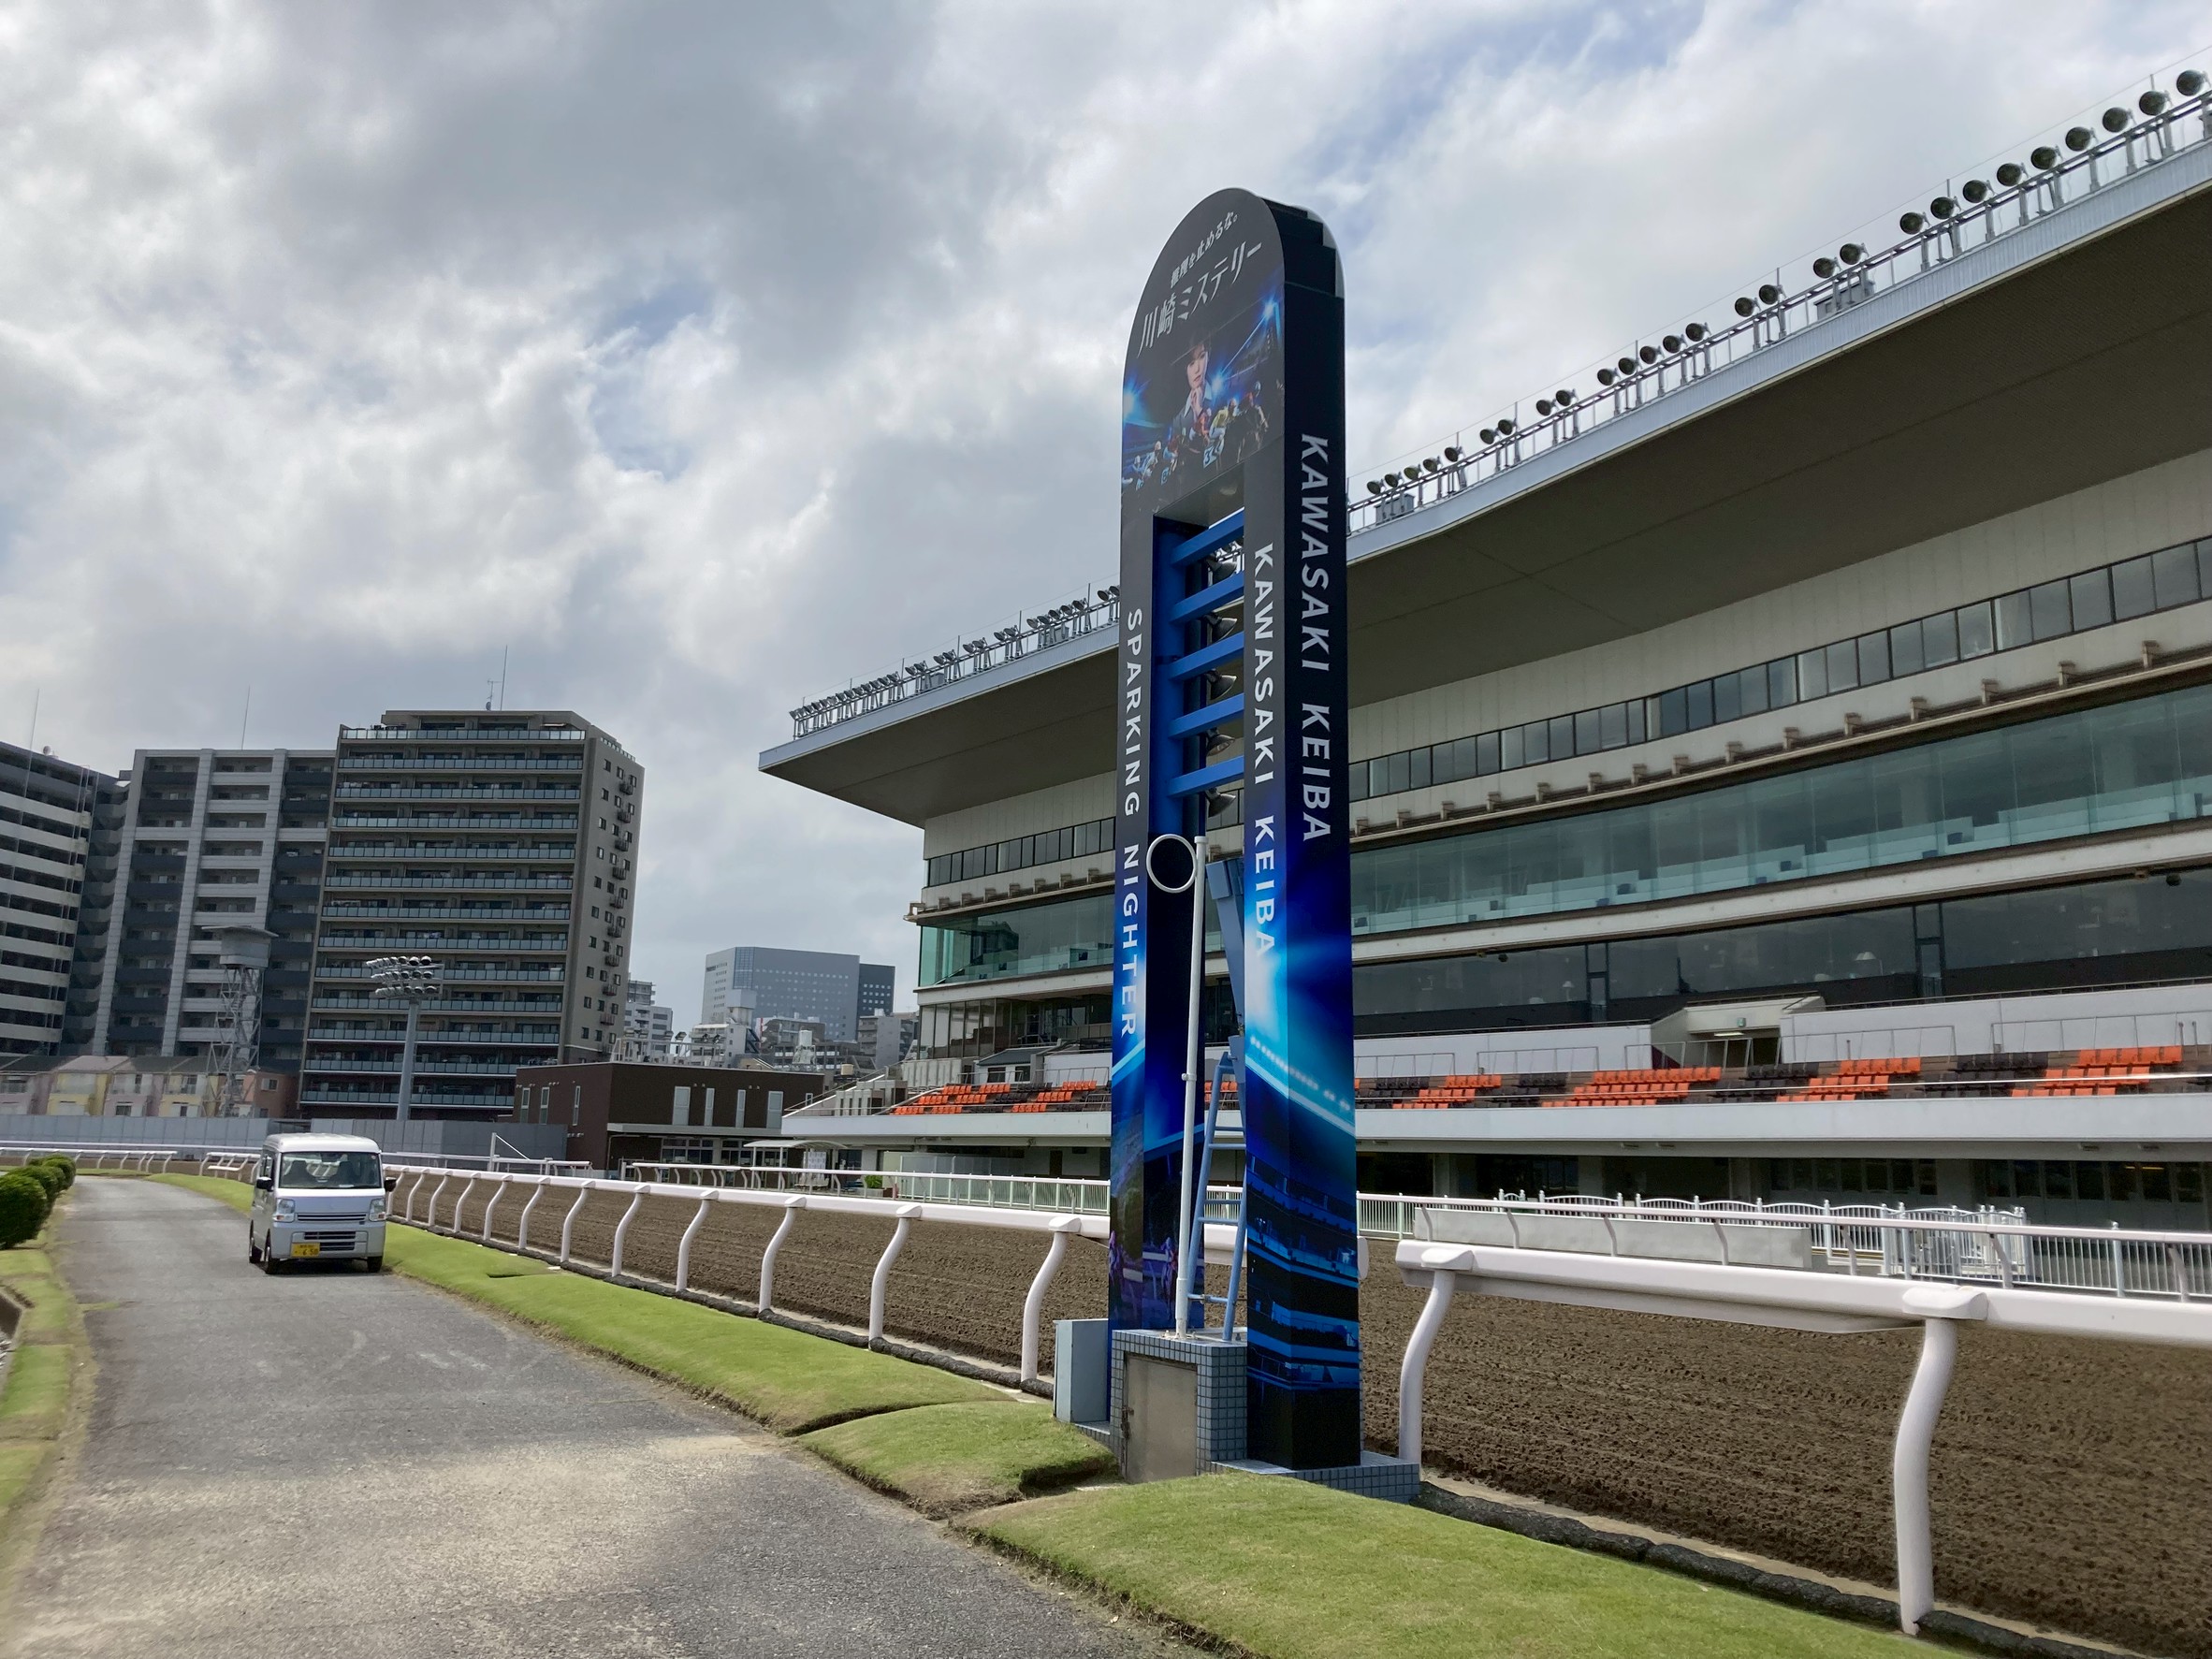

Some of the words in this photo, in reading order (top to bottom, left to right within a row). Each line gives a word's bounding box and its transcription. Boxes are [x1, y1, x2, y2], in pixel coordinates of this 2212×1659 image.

[1137, 240, 1262, 358] 川崎ミステリー
[1301, 433, 1330, 672] KAWASAKI
[1125, 608, 1142, 817] SPARKING
[1254, 542, 1274, 784] KAWASAKI
[1302, 703, 1331, 842] KEIBA
[1121, 844, 1140, 1038] NIGHTER
[1254, 815, 1275, 956] KEIBA
